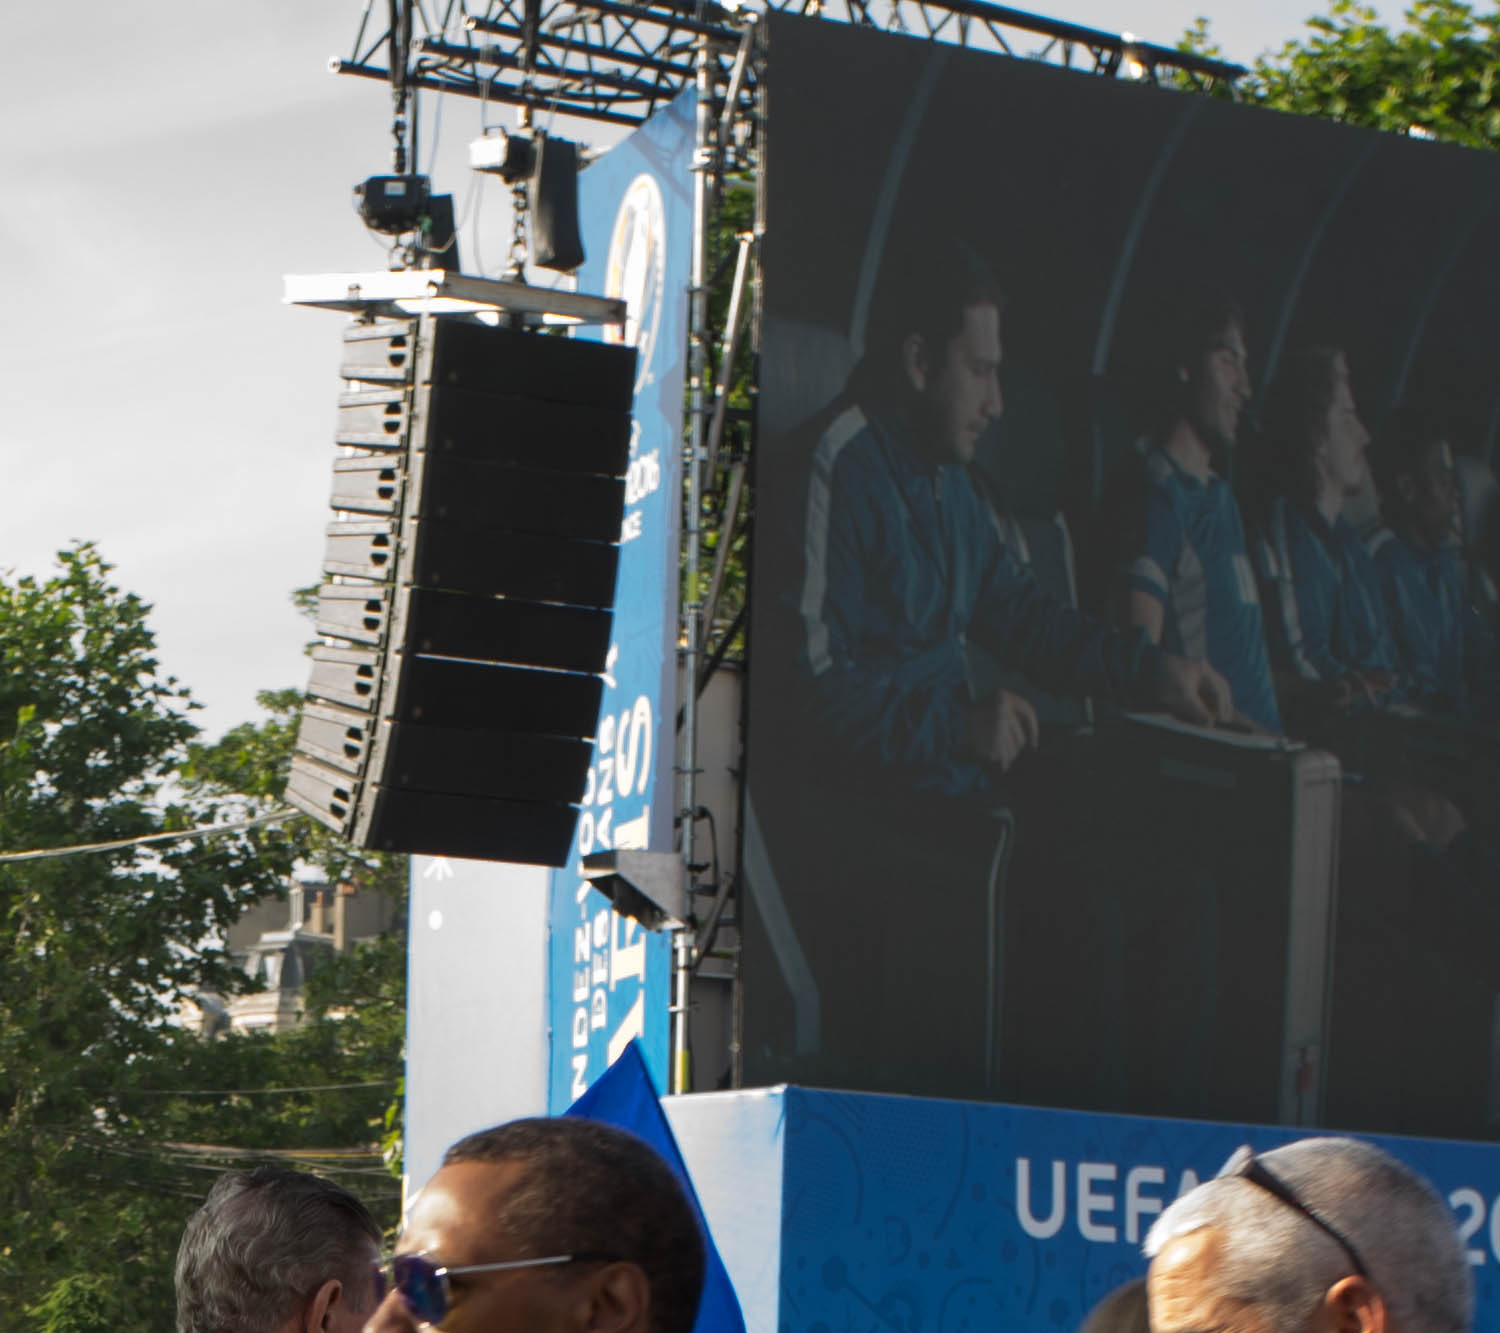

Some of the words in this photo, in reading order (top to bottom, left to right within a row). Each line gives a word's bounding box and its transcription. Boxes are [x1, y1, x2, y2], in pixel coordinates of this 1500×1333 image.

[597, 714, 615, 849] ANS
[592, 909, 608, 1030] DES
[1016, 1157, 1198, 1245] UEF
